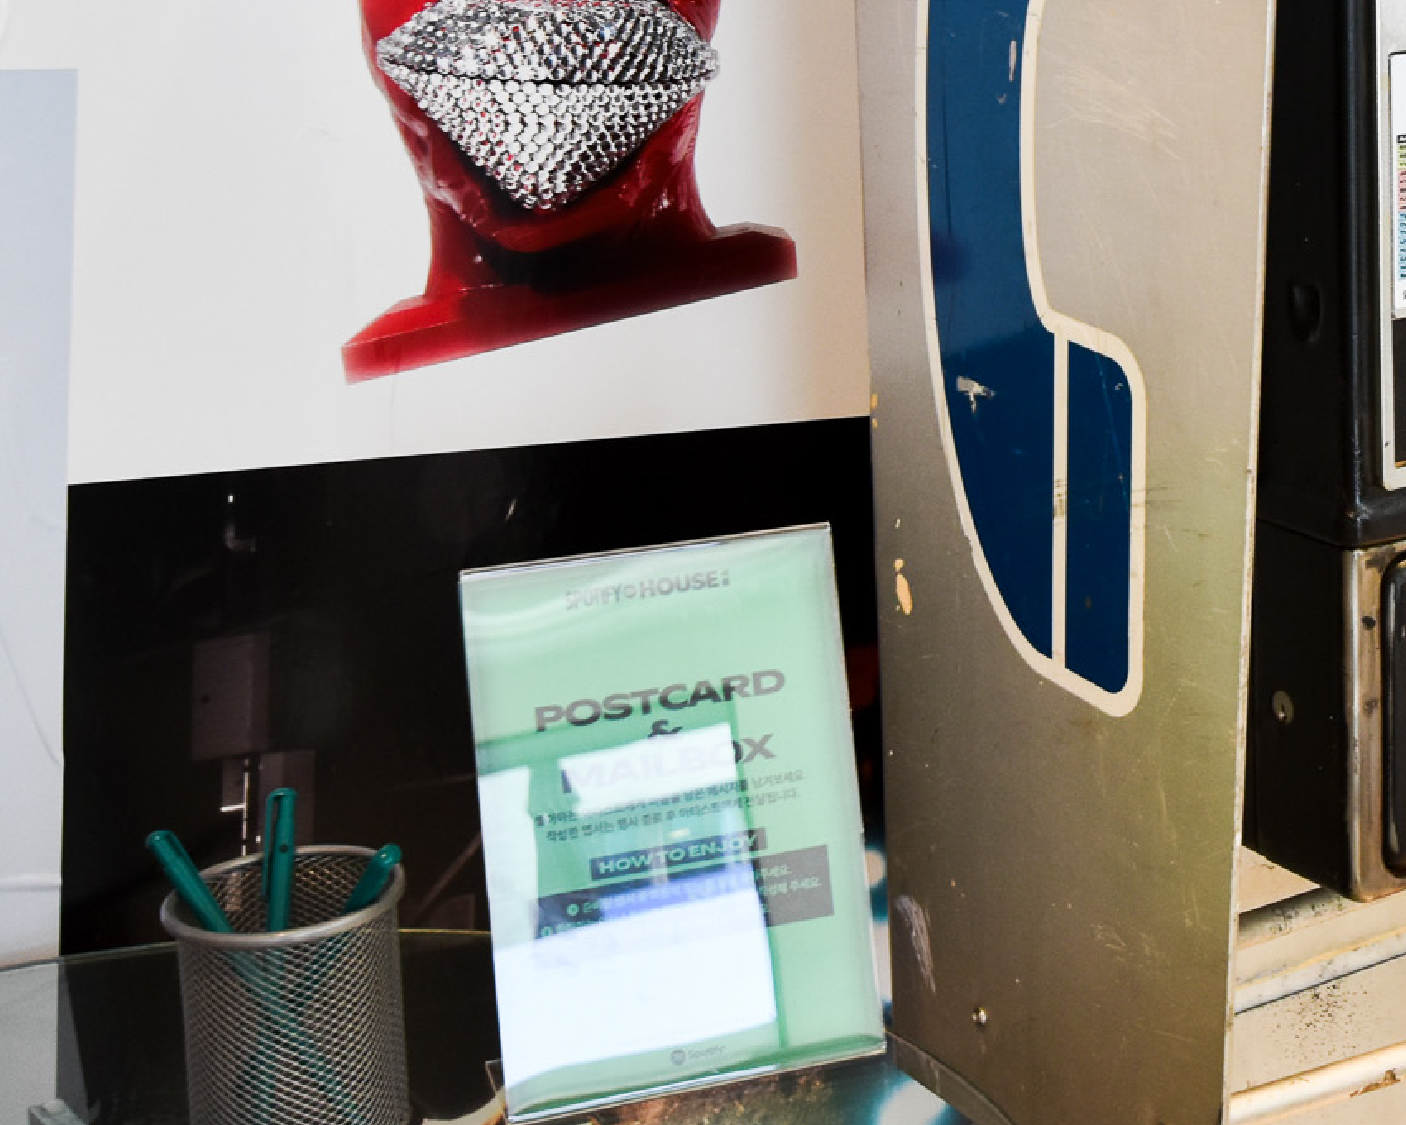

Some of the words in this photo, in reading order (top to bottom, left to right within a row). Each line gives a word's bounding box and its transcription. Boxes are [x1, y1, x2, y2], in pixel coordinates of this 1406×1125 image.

[534, 669, 786, 733] POSTCARD
[598, 852, 652, 875] HOW
[656, 844, 687, 867] TO
[688, 833, 757, 861] ENJOY
